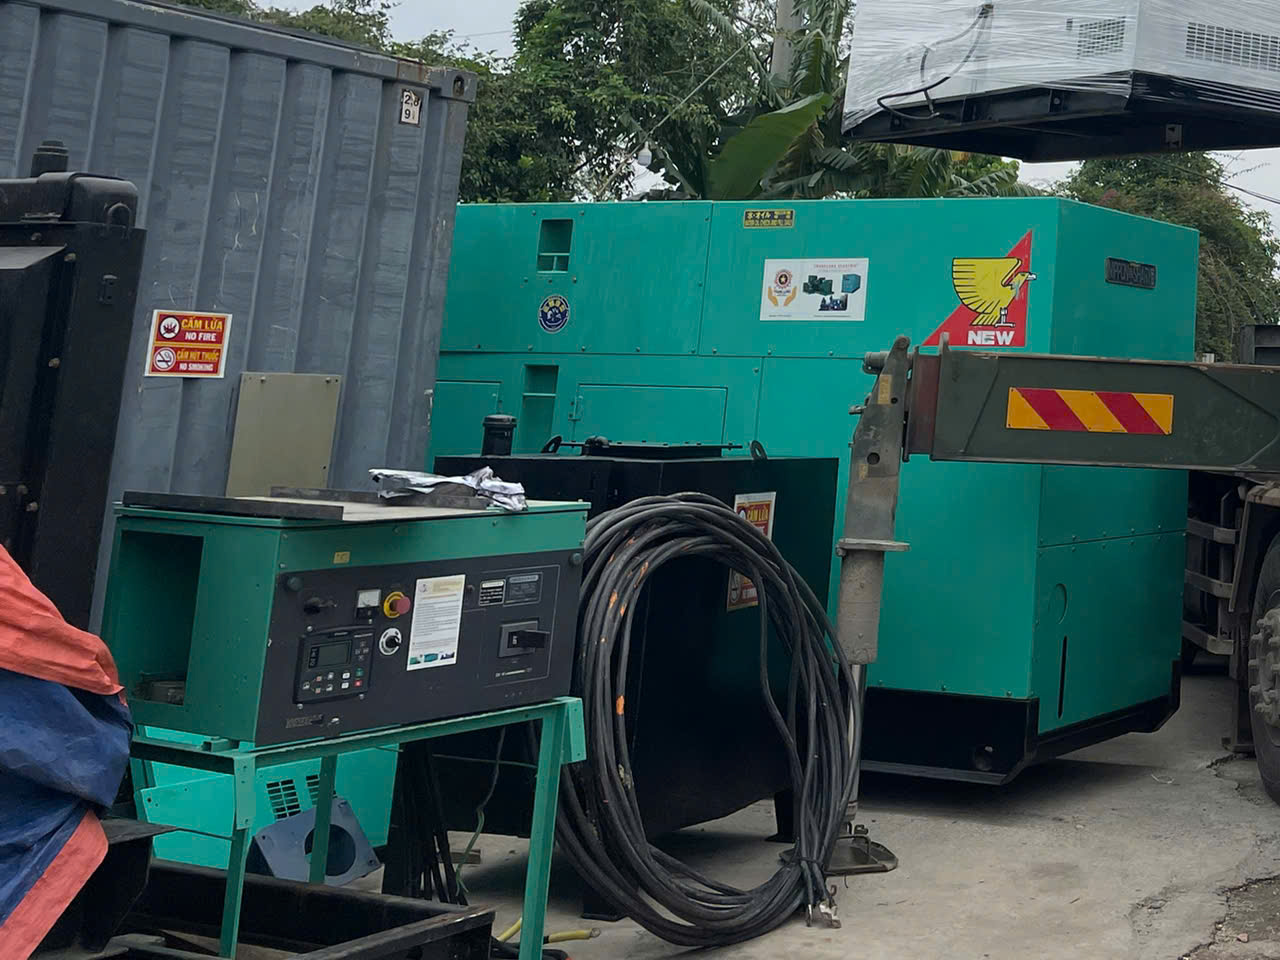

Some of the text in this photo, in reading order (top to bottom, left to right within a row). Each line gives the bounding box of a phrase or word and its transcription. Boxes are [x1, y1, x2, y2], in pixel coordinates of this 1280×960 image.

[181, 316, 202, 330] CẤM
[185, 331, 217, 342] NO FIRE
[967, 330, 1015, 345] NEW
